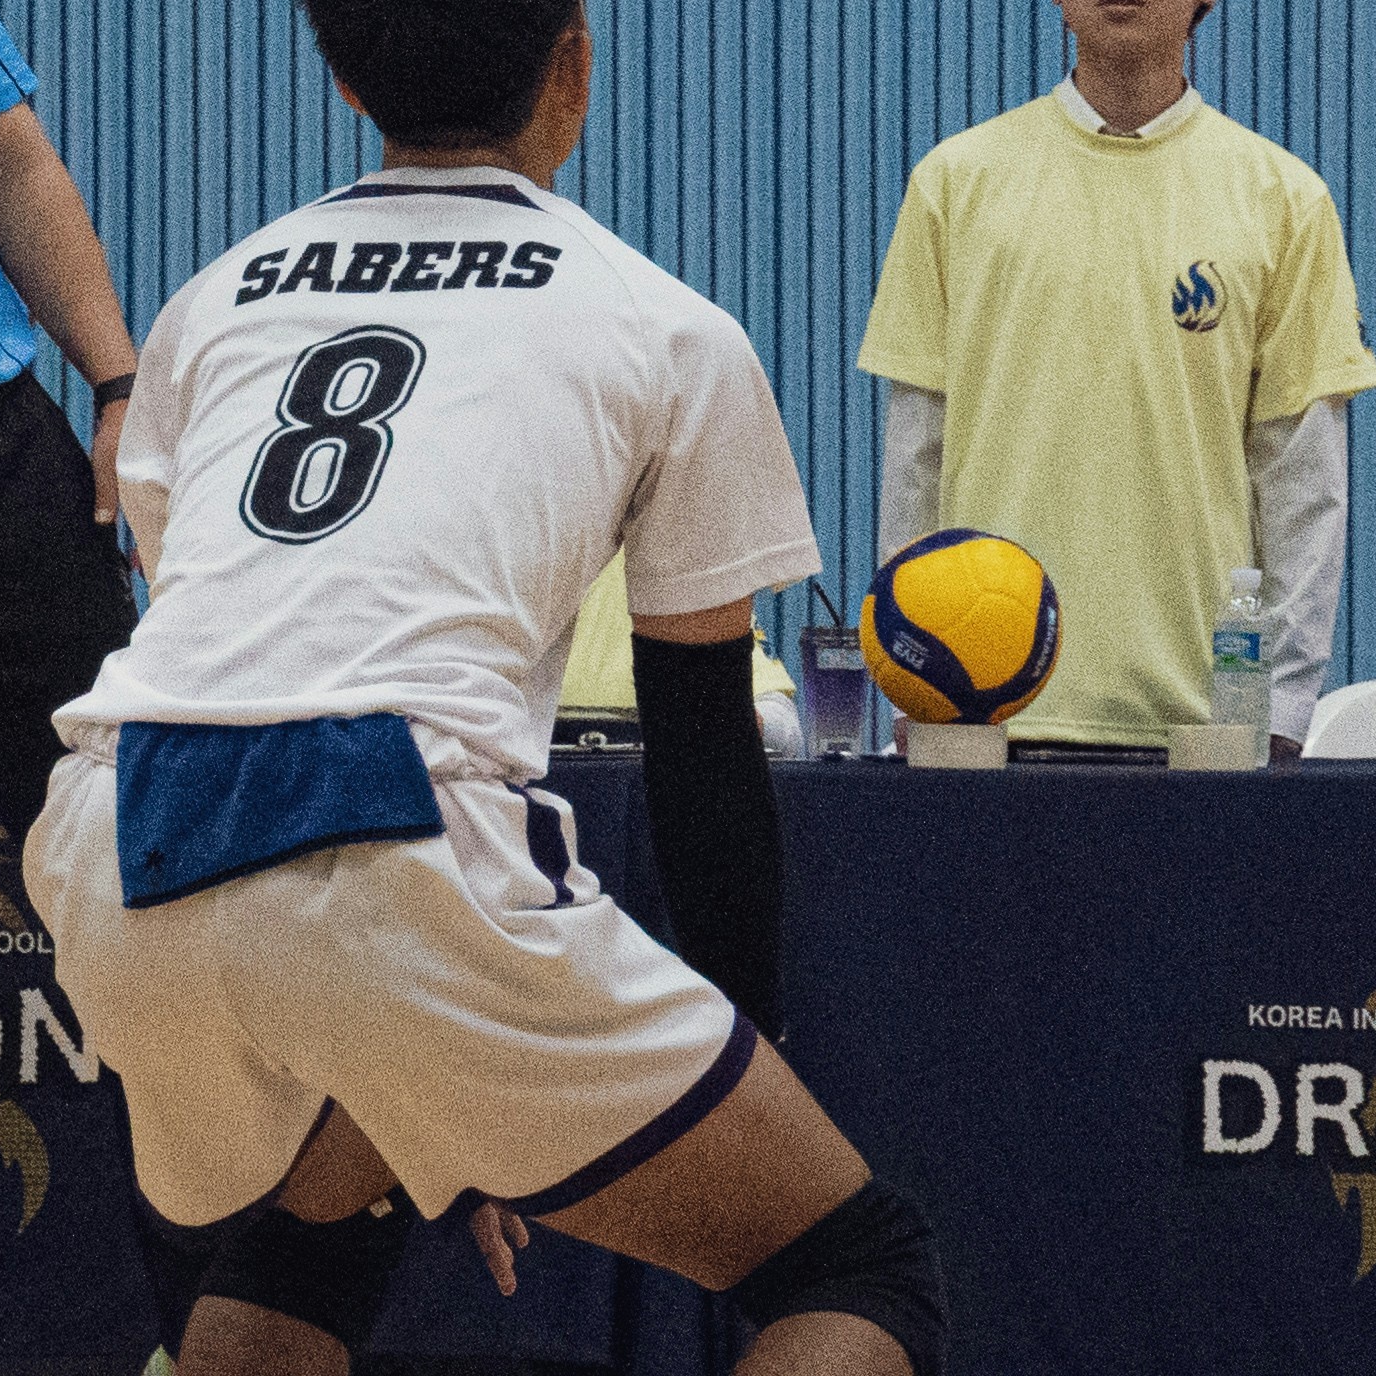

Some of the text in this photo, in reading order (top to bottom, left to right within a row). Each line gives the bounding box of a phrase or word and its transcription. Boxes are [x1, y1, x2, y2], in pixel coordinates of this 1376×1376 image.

[235, 240, 563, 307] SABERS
[238, 323, 427, 546] 8
[1248, 1004, 1343, 1029] KOREA
